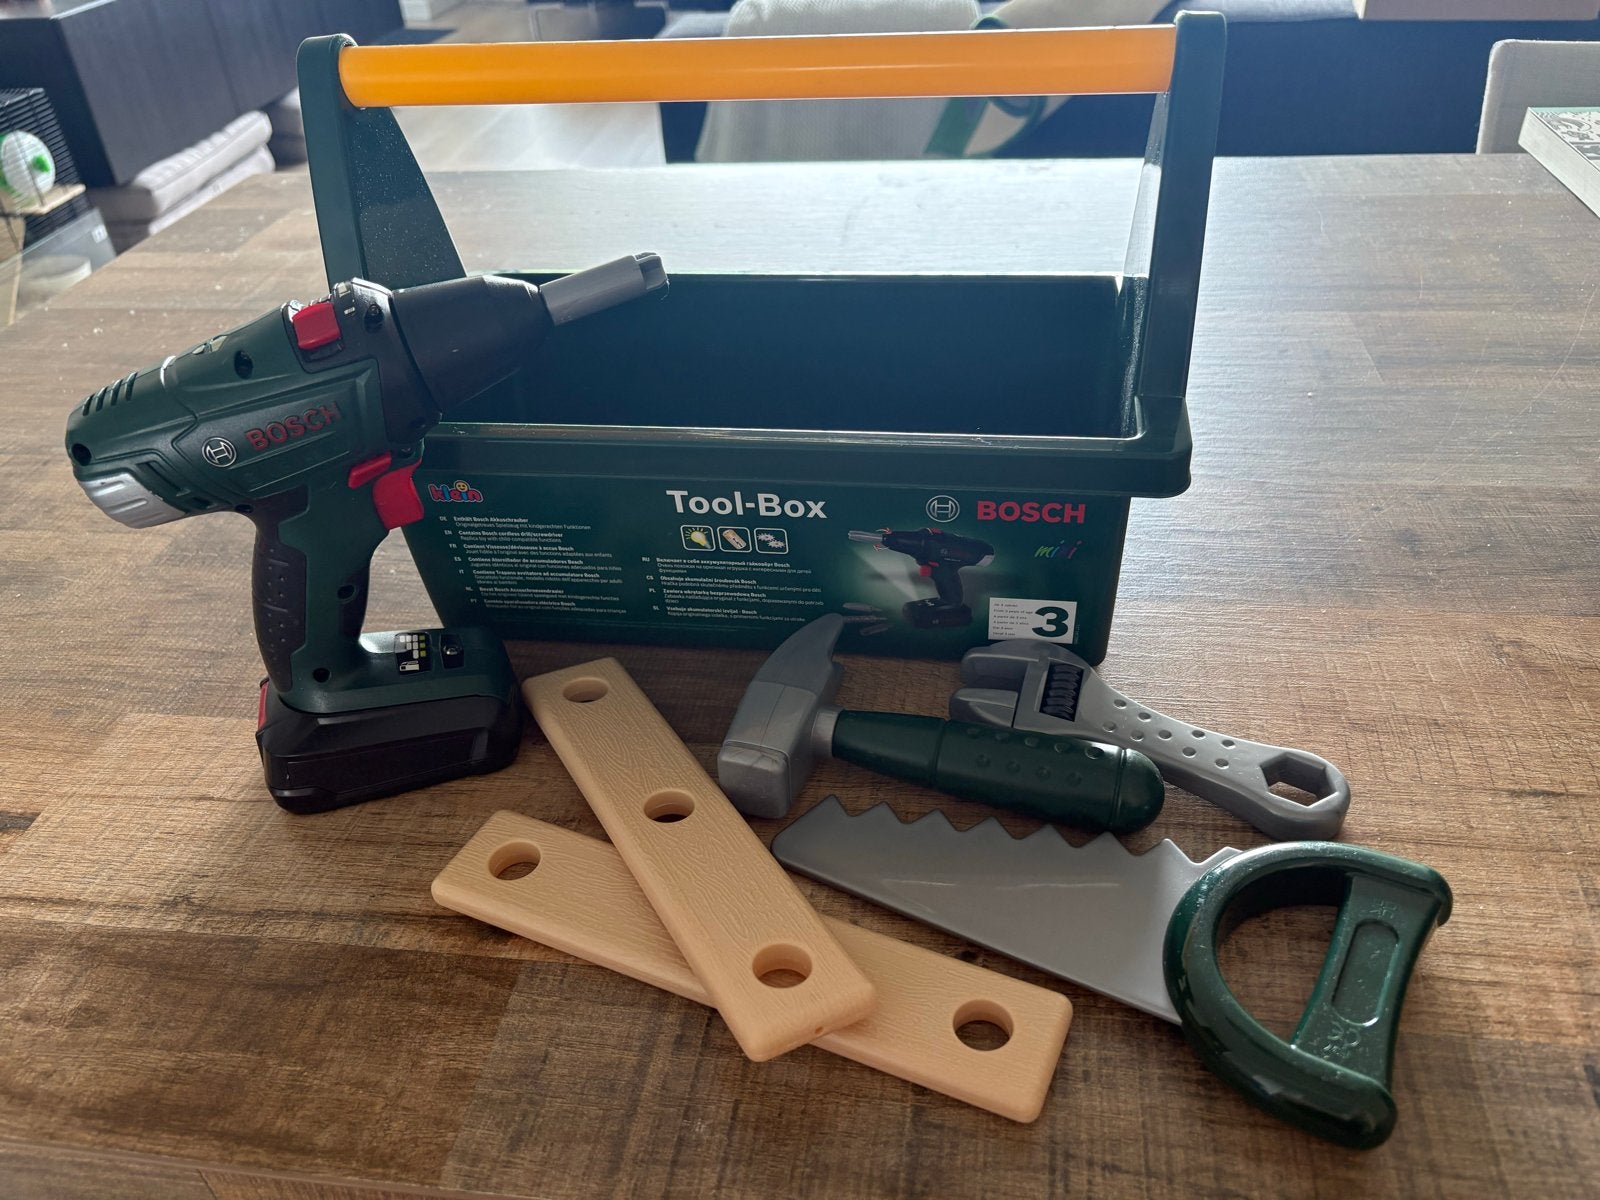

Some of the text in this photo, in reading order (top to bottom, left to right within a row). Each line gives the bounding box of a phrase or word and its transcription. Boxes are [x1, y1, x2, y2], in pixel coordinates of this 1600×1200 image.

[244, 402, 343, 452] BOSCH
[428, 481, 484, 502] klein
[666, 490, 828, 518] Tool-Box
[977, 500, 1086, 524] BOSCH
[1032, 606, 1069, 638] 3
